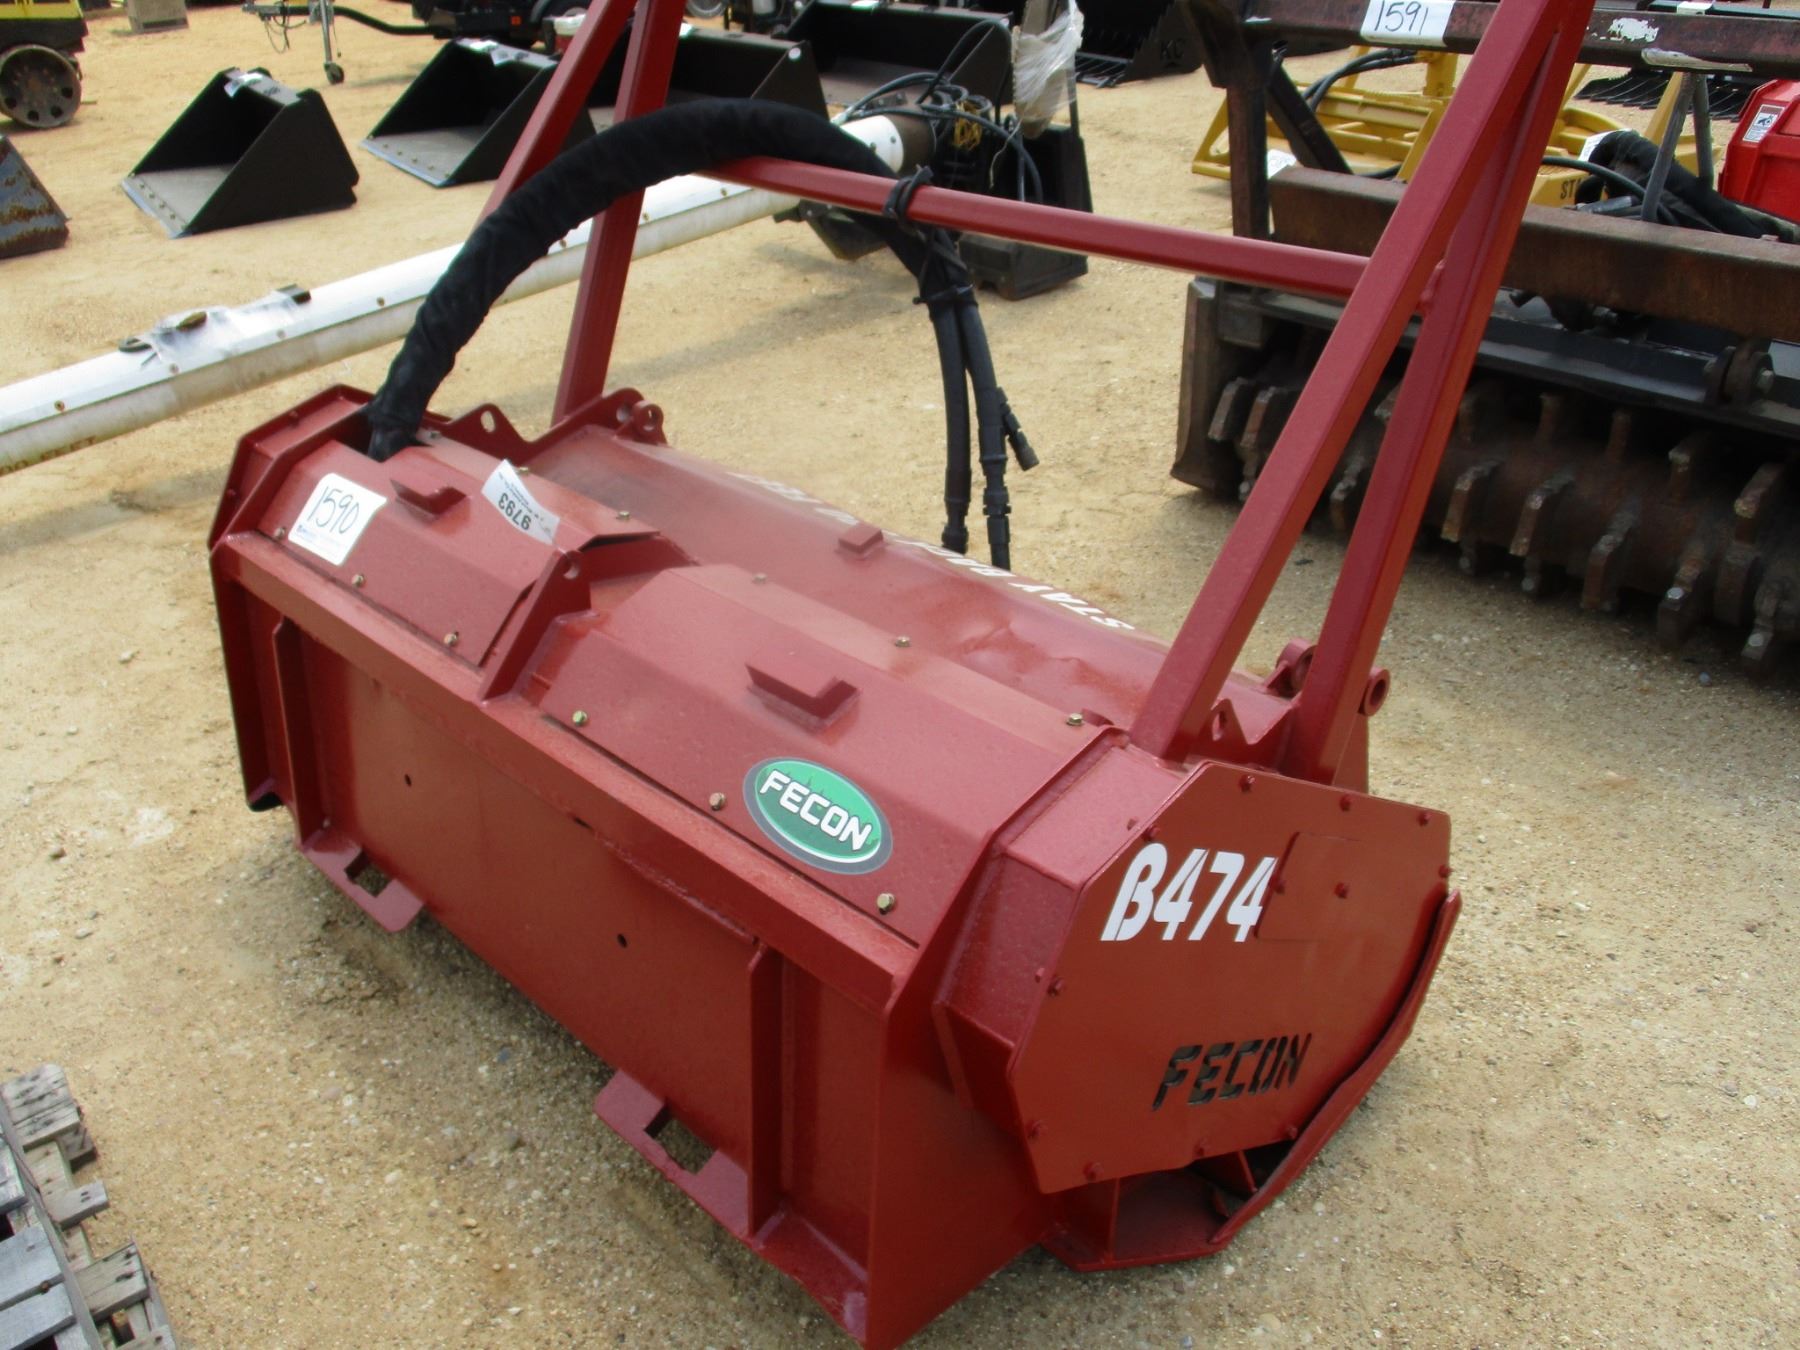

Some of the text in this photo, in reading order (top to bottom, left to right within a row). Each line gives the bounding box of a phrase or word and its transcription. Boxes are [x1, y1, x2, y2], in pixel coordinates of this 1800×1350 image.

[1374, 0, 1429, 35] 1591
[1560, 180, 1583, 199] ST
[307, 486, 360, 534] 1590
[498, 492, 532, 530] 9793
[1008, 582, 1135, 630] STAY
[760, 770, 872, 850] FECON
[1101, 843, 1278, 942] B474
[1152, 1032, 1312, 1111] FECON
